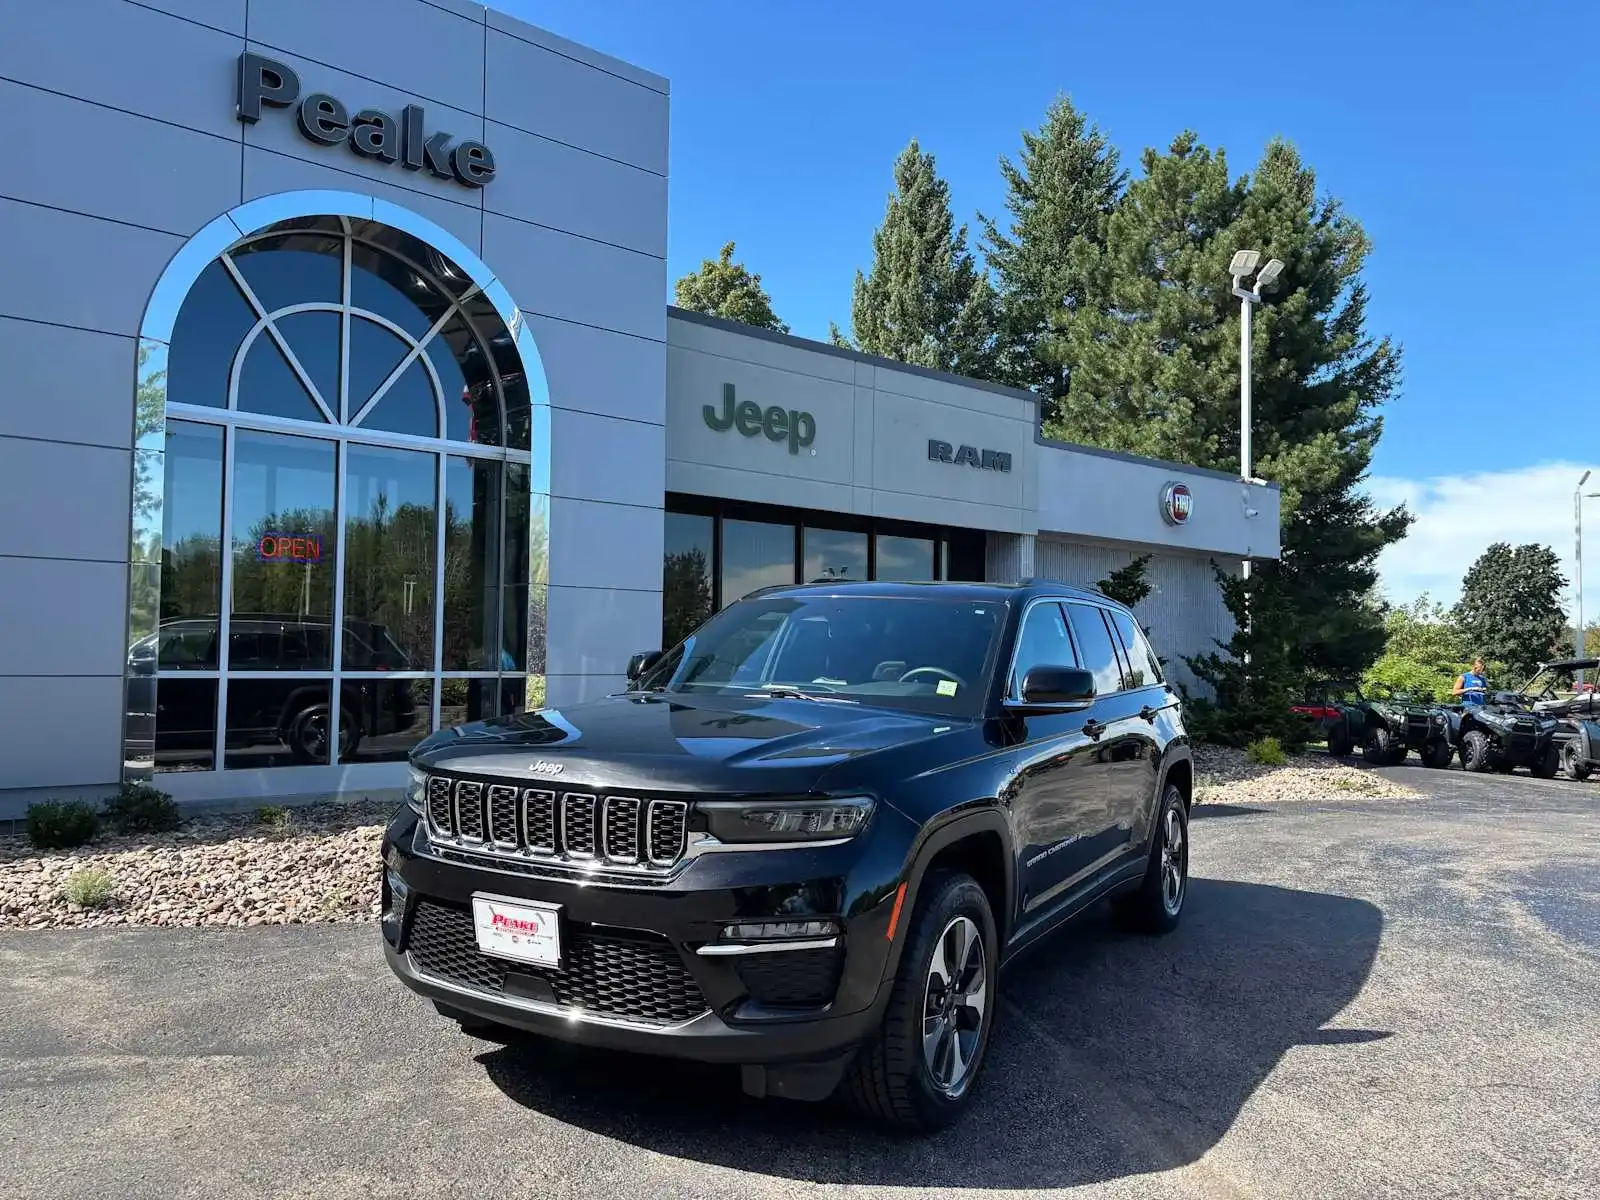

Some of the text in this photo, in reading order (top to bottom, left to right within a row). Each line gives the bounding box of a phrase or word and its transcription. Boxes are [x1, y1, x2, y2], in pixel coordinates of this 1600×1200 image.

[236, 50, 497, 189] Peake
[702, 383, 816, 455] Jeep
[928, 439, 1012, 474] RAM
[260, 536, 320, 560] OPEN
[529, 760, 564, 775] Jeep
